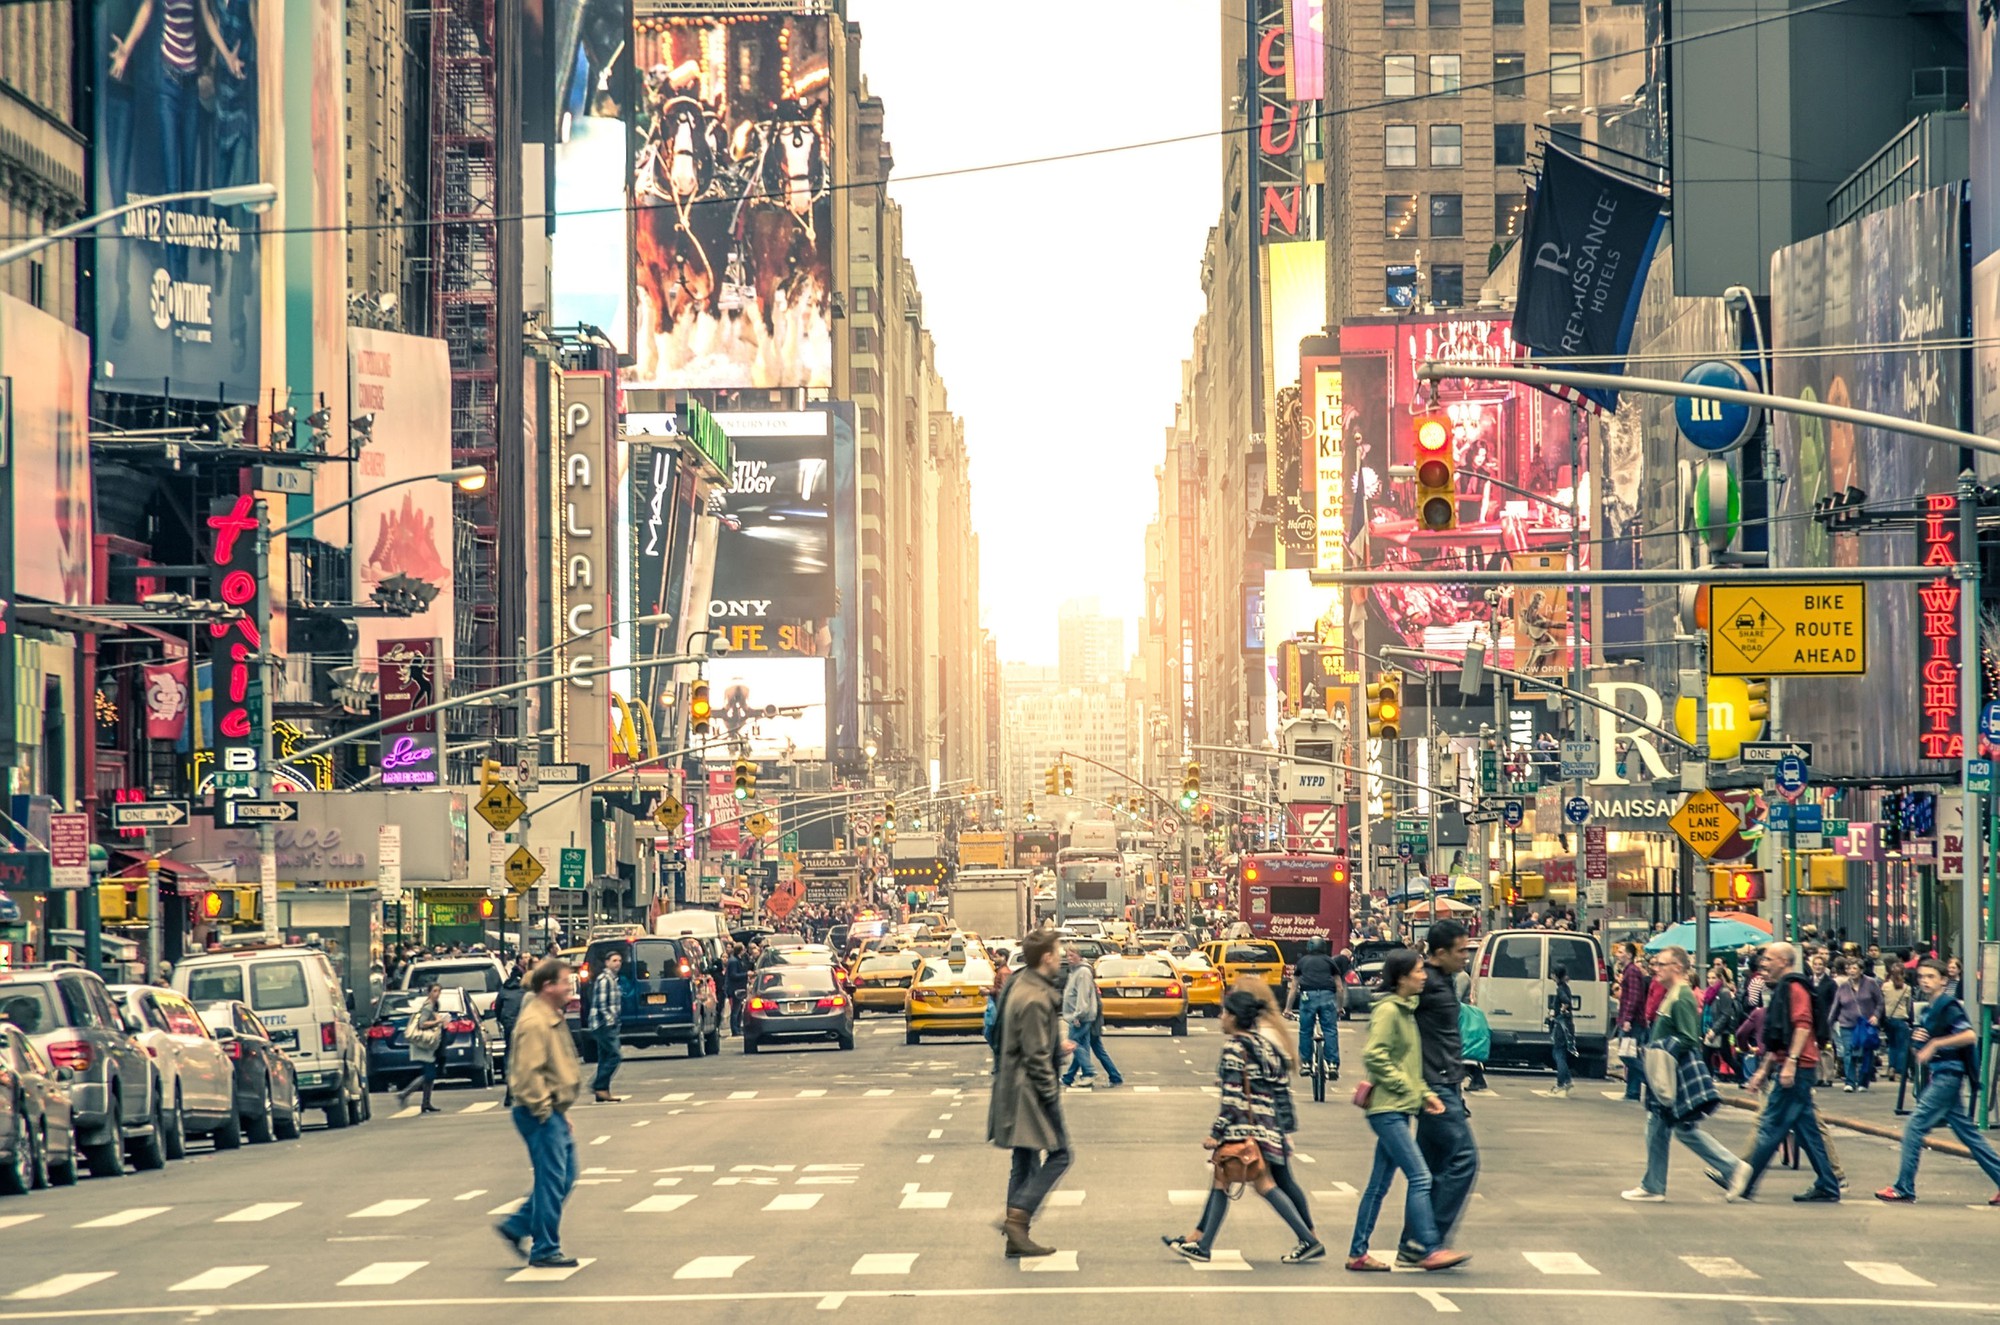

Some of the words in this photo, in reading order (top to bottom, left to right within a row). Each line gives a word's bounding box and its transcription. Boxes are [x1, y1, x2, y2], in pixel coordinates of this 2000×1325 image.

[121, 207, 146, 240] JAN
[147, 208, 161, 243] 12
[165, 210, 218, 250] SUNDAYS
[1590, 249, 1621, 313] HOTELS
[151, 267, 212, 330] SHOWTIME
[566, 402, 594, 688] PALACE
[1804, 595, 1845, 610] BIKE
[1918, 494, 1961, 731] PLAWRIGHT
[1738, 630, 1765, 638] SHARE
[1795, 622, 1853, 637] ROUTE
[1793, 649, 1856, 663] AHEAD
[1588, 682, 1674, 786] R
[382, 737, 432, 769] Lace
[1749, 748, 1771, 759] ONE
[1561, 761, 1597, 769] SECURITY
[1969, 762, 1990, 775] M20
[1563, 768, 1594, 776] CAMERA
[1299, 775, 1326, 787] NYPD
[125, 809, 143, 820] ONE
[154, 807, 178, 820] WAY
[242, 807, 261, 815] ONE
[270, 807, 289, 815] WAY
[1687, 803, 1720, 814] RIGHT
[1400, 822, 1429, 832] Broaay
[1688, 816, 1720, 828] LANE
[1689, 830, 1720, 842] ENDS
[805, 857, 847, 867] nuchas
[1270, 916, 1293, 925] New
[1293, 916, 1316, 925] York
[1269, 926, 1330, 937] Sightseeing
